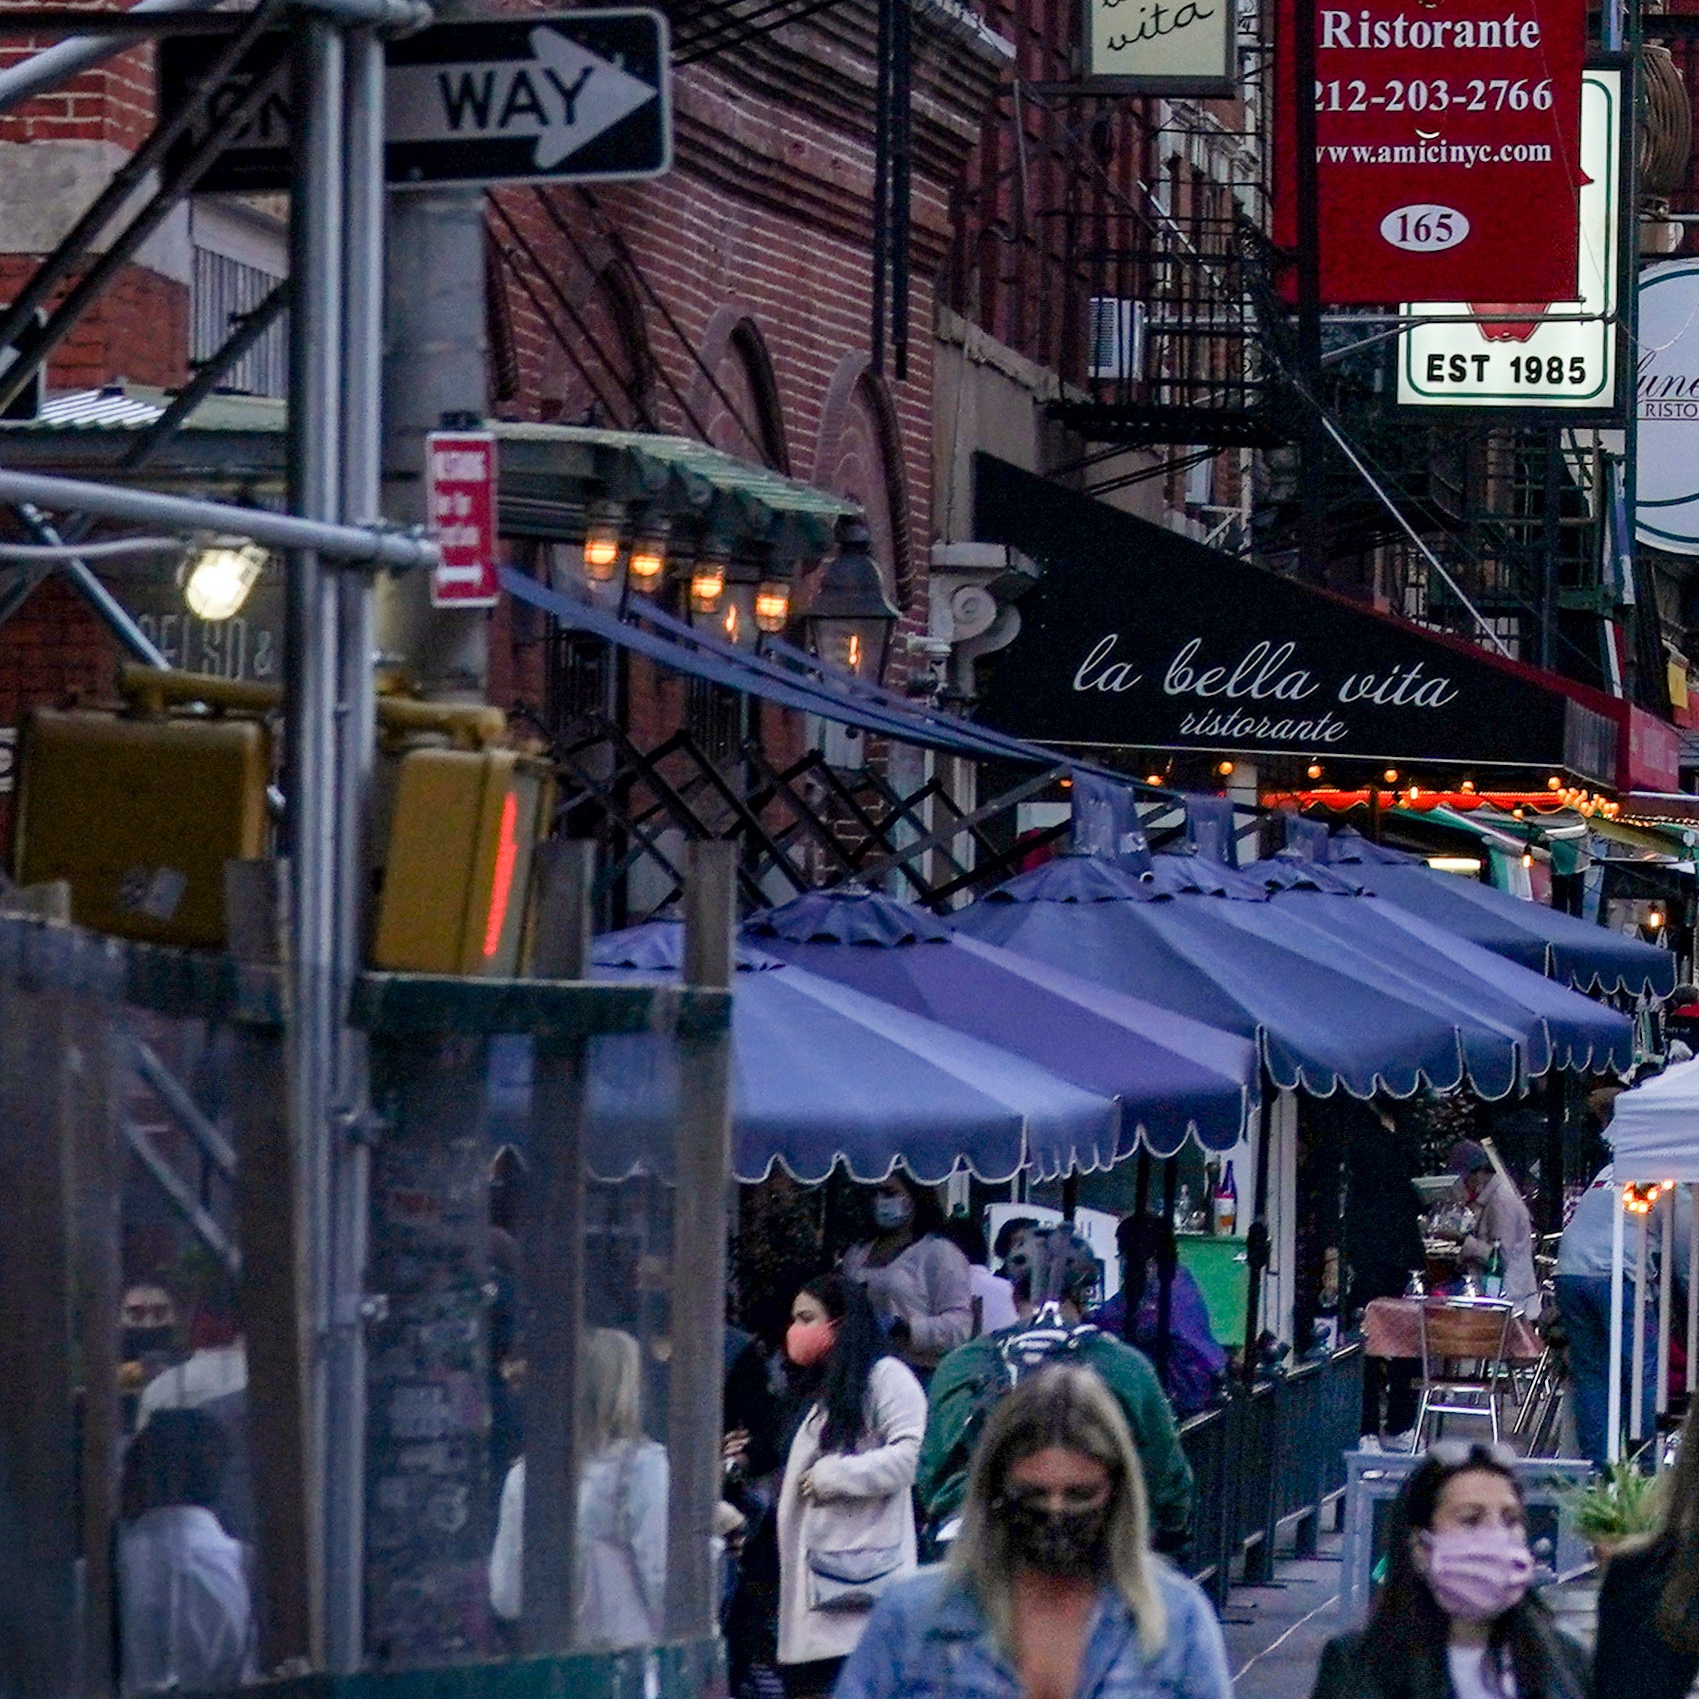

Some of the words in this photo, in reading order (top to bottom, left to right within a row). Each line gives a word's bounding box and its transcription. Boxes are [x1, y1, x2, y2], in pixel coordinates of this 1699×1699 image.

[1107, 0, 1216, 52] vita
[1319, 9, 1541, 51] Ristorante
[438, 66, 596, 132] WAY
[1396, 213, 1454, 244] 165
[1426, 354, 1490, 384] EST
[1509, 356, 1587, 386] 1985
[1072, 634, 1142, 693] la
[1163, 637, 1321, 701] bella
[1338, 661, 1461, 708] vita
[1178, 707, 1349, 743] ristorante
